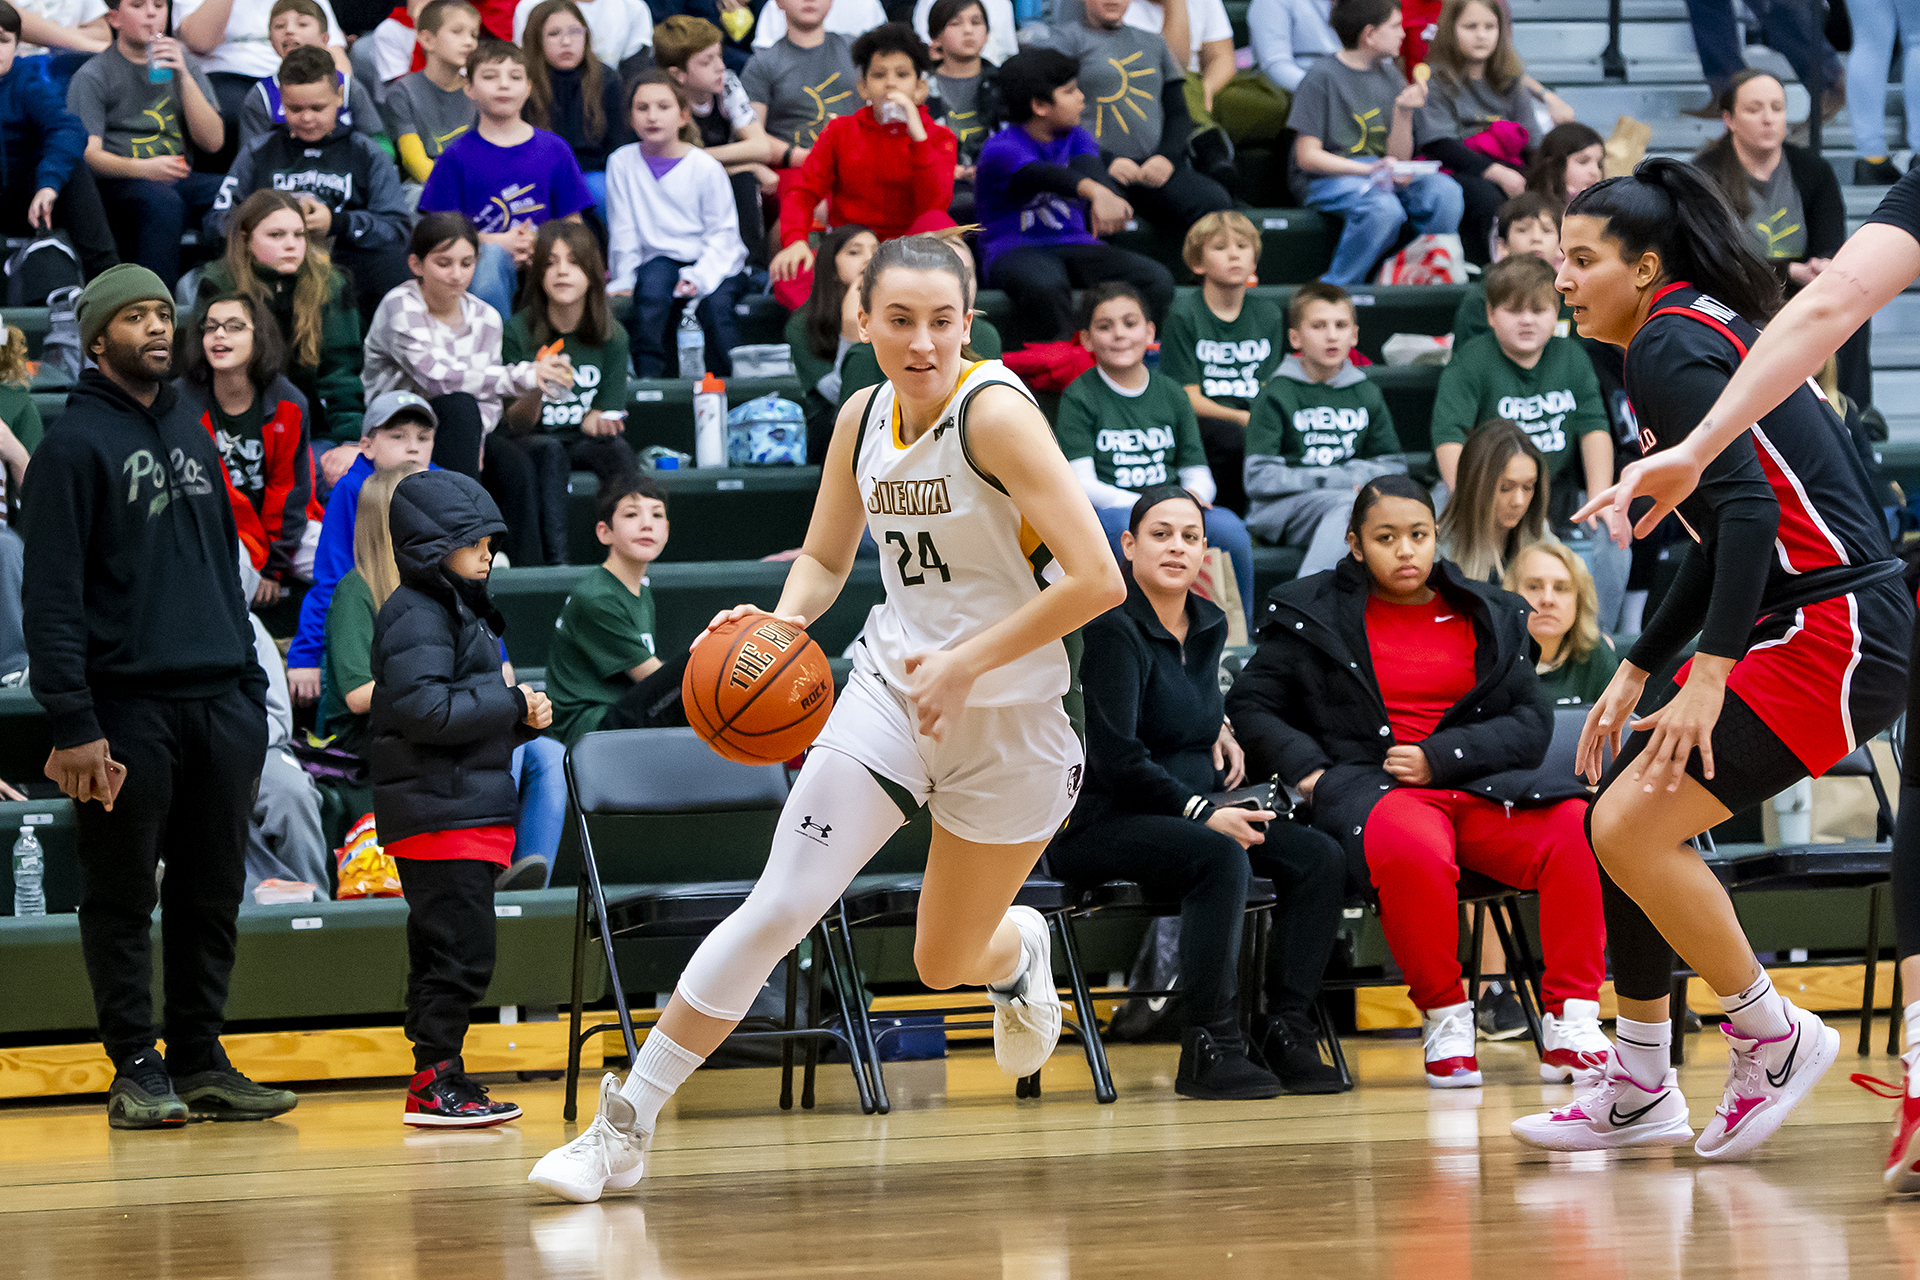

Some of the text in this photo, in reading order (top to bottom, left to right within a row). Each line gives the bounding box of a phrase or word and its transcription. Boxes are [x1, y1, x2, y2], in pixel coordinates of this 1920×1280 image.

[1195, 337, 1271, 365] ORENDA
[1203, 378, 1260, 399] 2023
[1497, 389, 1577, 420] ORENDA
[1293, 406, 1370, 432] ORENDA
[1096, 425, 1176, 453] ORENDA
[1530, 429, 1566, 453] 023
[1114, 462, 1168, 488] 2023
[867, 475, 952, 516] SIENA
[885, 530, 952, 587] 24
[728, 641, 777, 692] THE
[800, 679, 828, 711] ROCK
